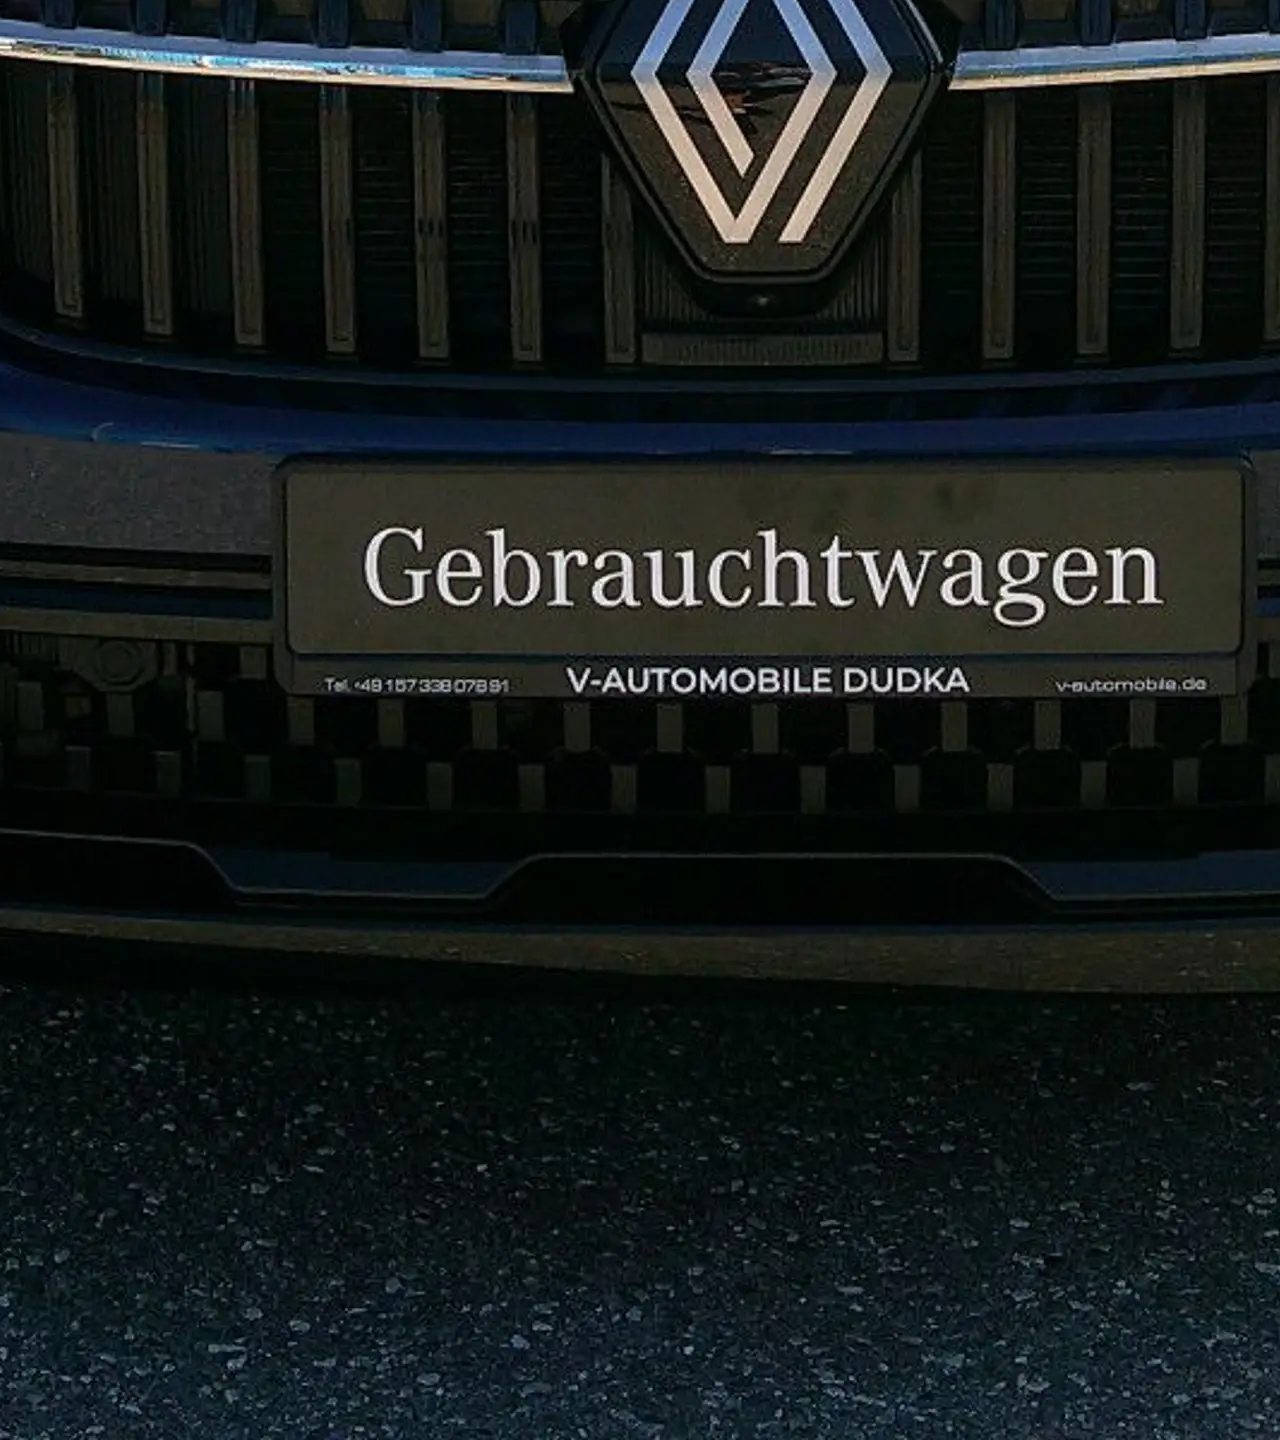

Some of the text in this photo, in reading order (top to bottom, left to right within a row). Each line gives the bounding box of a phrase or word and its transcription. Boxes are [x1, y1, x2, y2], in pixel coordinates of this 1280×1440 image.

[363, 526, 1164, 628] Gebrauchtwagen
[566, 666, 970, 694] V-AUTOMOBILE DUDKA
[1055, 675, 1208, 693] v-automobile.de
